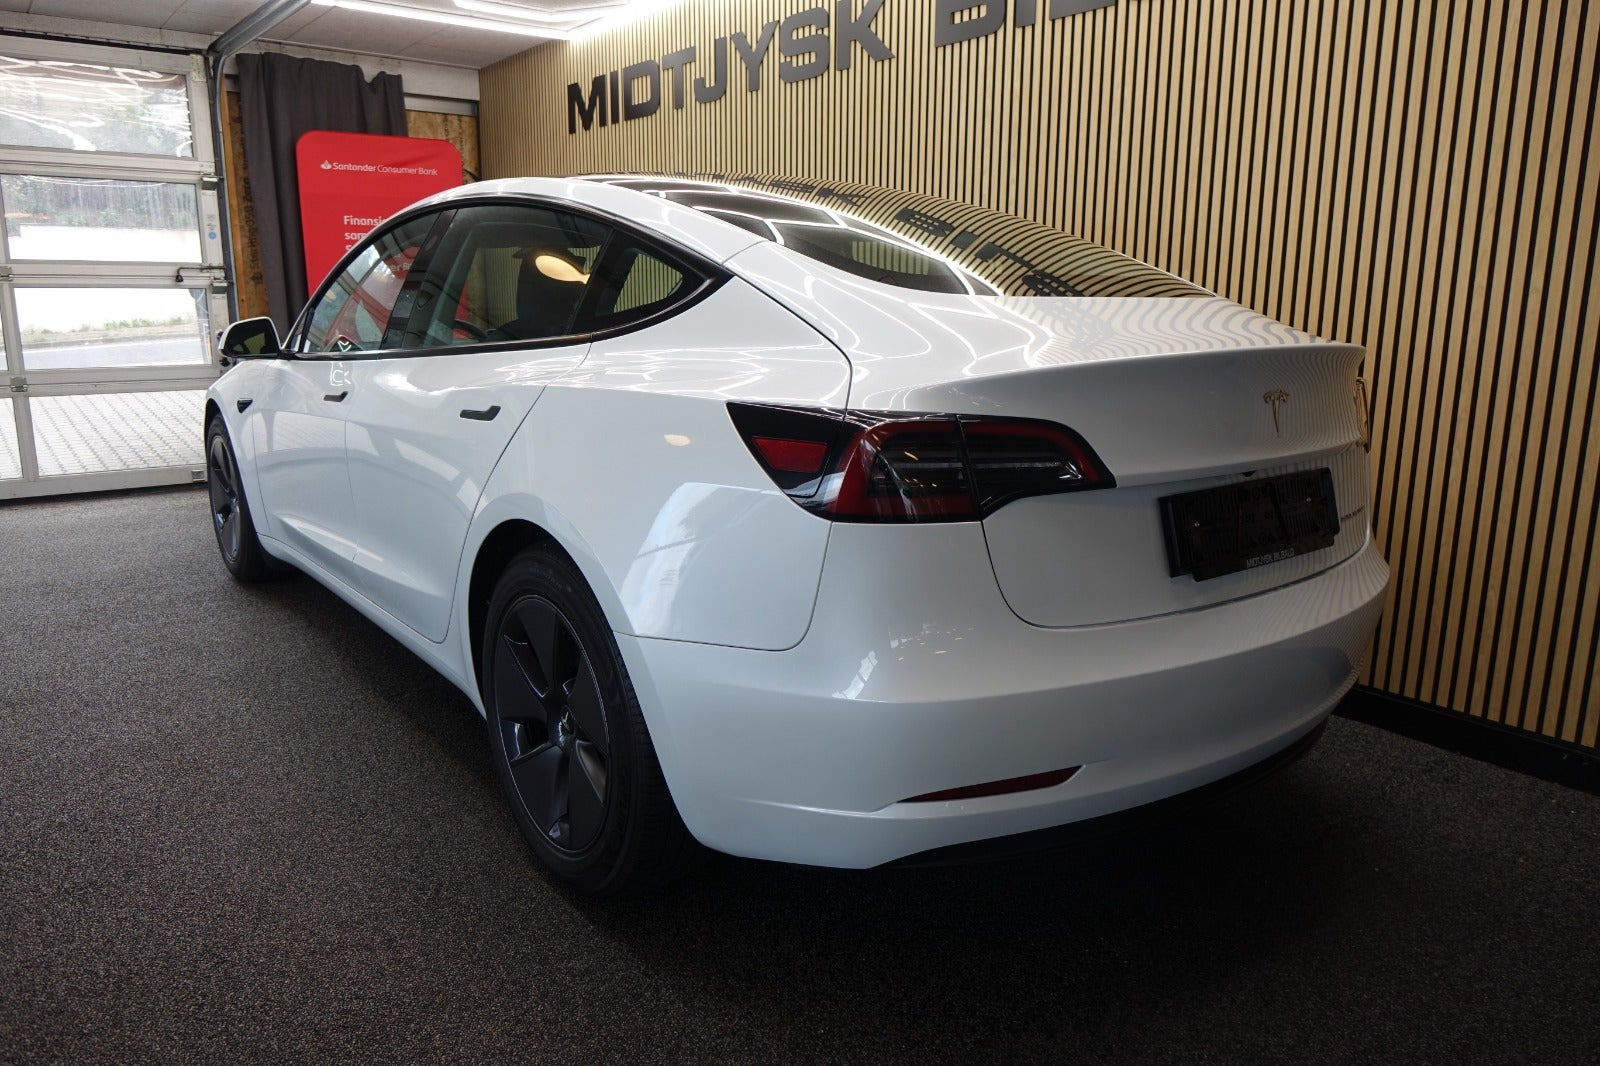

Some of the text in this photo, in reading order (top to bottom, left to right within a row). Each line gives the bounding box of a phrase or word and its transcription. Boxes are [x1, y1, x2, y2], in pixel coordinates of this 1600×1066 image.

[567, 0, 896, 134] MIDTJYSK
[332, 162, 438, 176] Santander Consumer Bank
